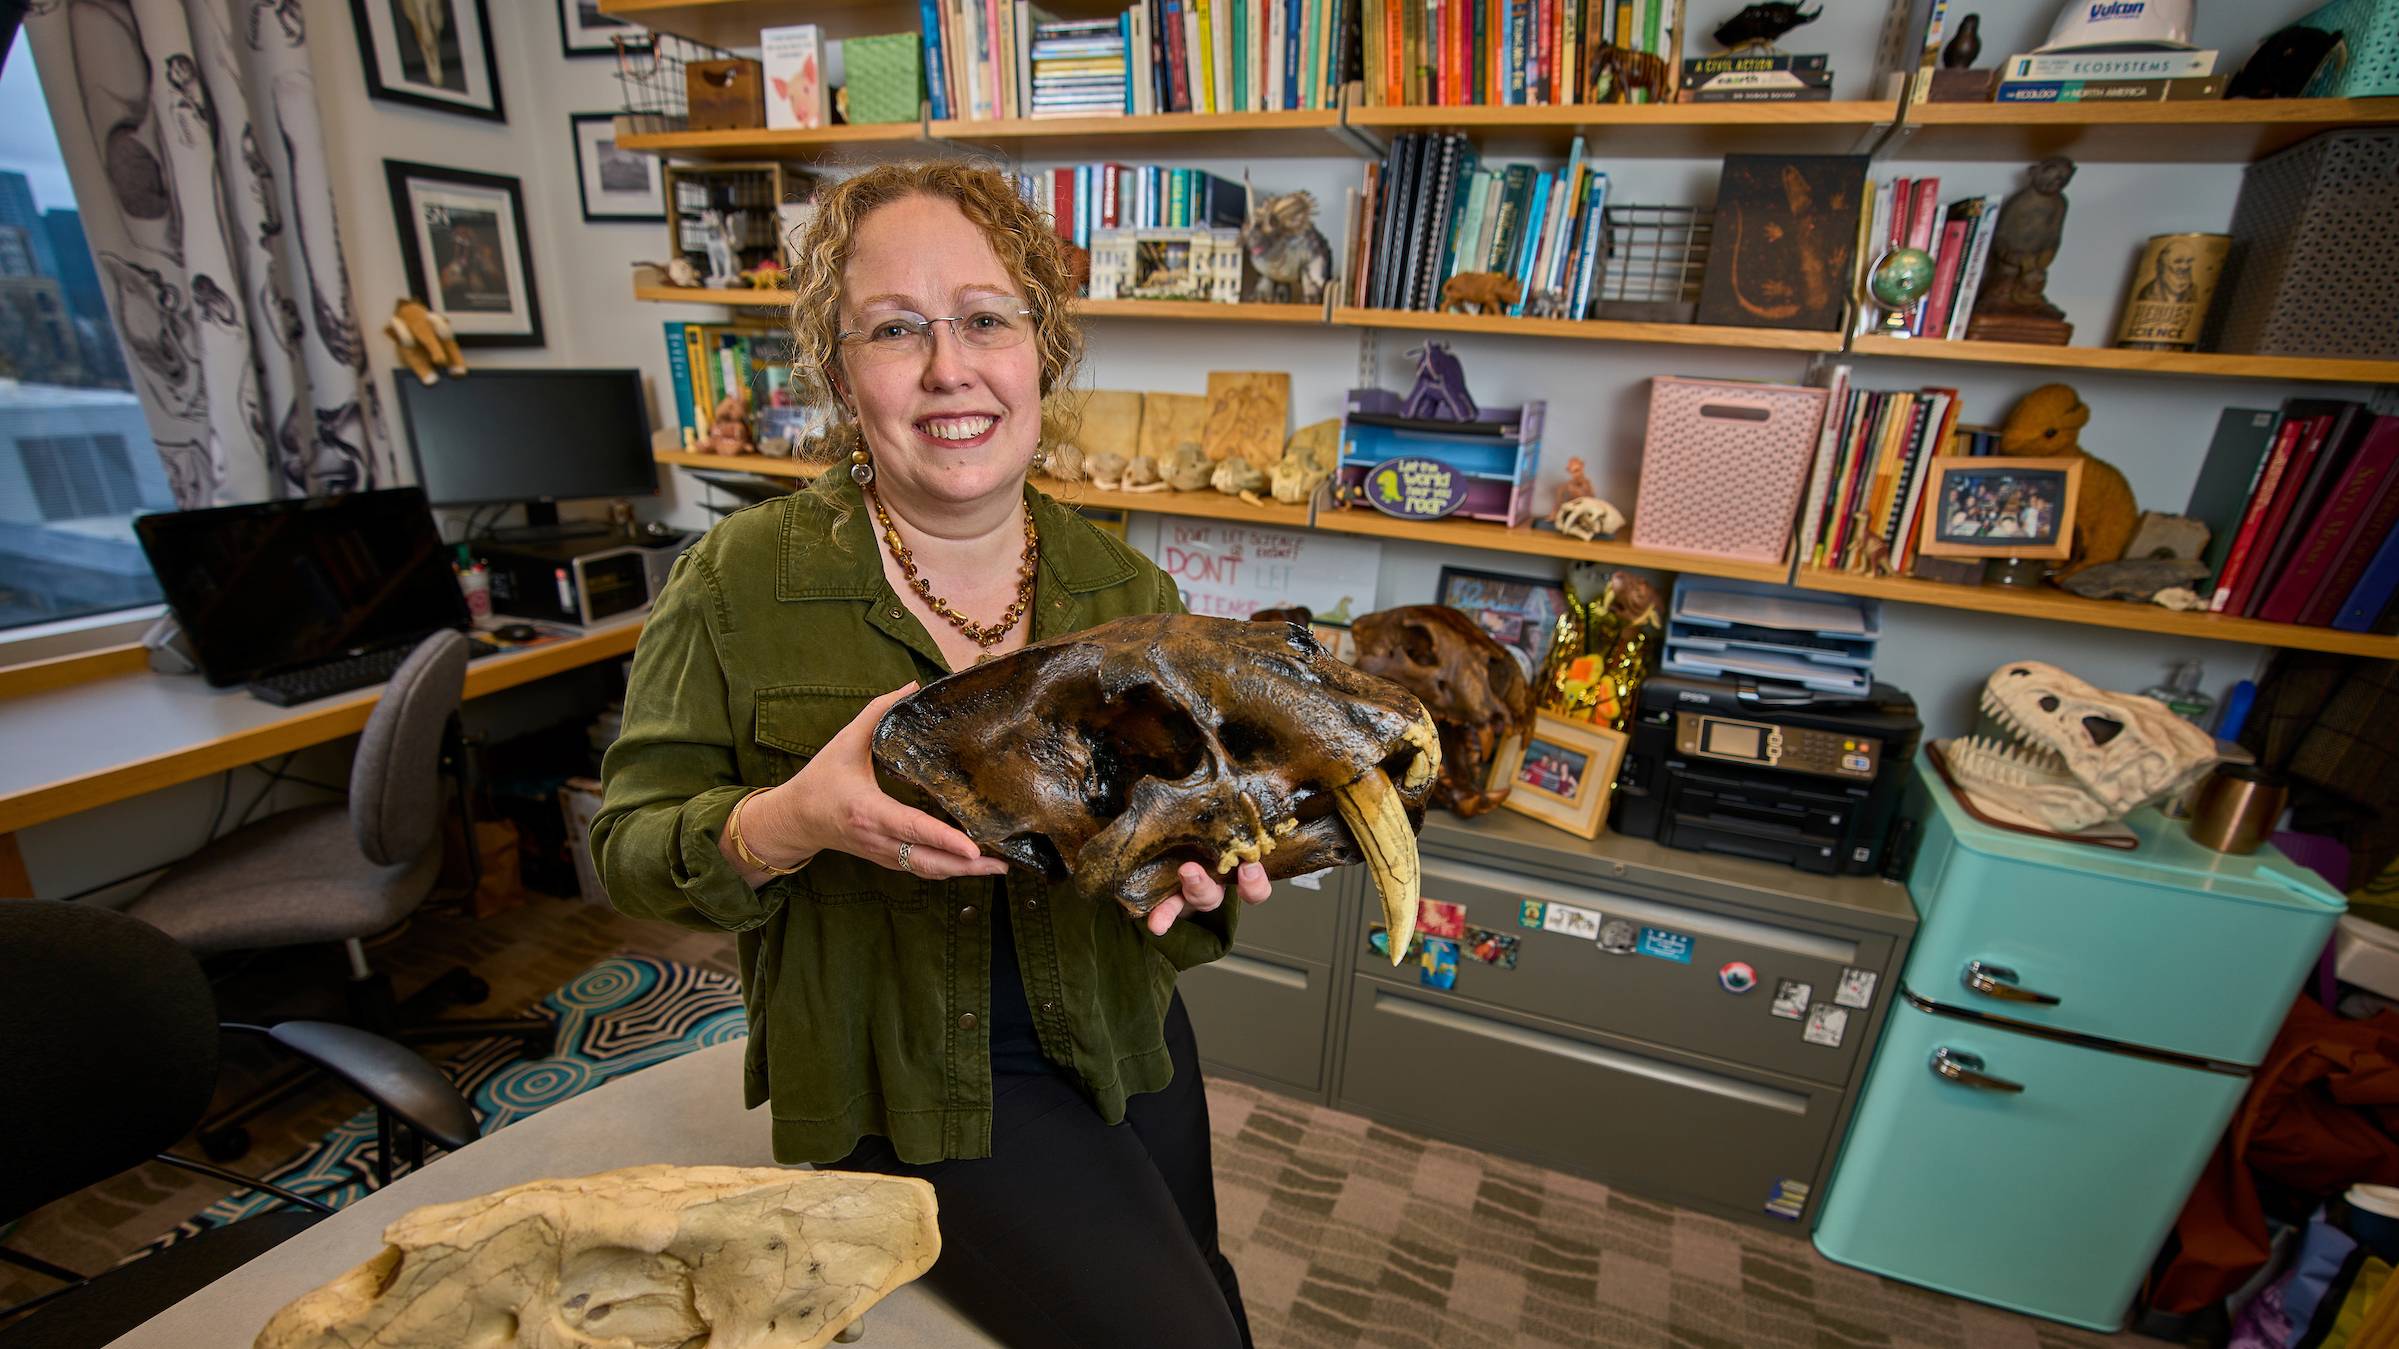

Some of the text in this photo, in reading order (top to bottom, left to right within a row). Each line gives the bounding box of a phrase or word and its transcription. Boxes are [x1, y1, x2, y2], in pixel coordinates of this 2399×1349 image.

[2090, 1, 2145, 18] Vulcan
[1736, 58, 1774, 71] ACTION
[2074, 61, 2170, 74] ECOSYSTEMS
[2106, 87, 2148, 97] AMERICA
[1404, 496, 1448, 515] roar
[1678, 691, 1711, 704] EPSON
